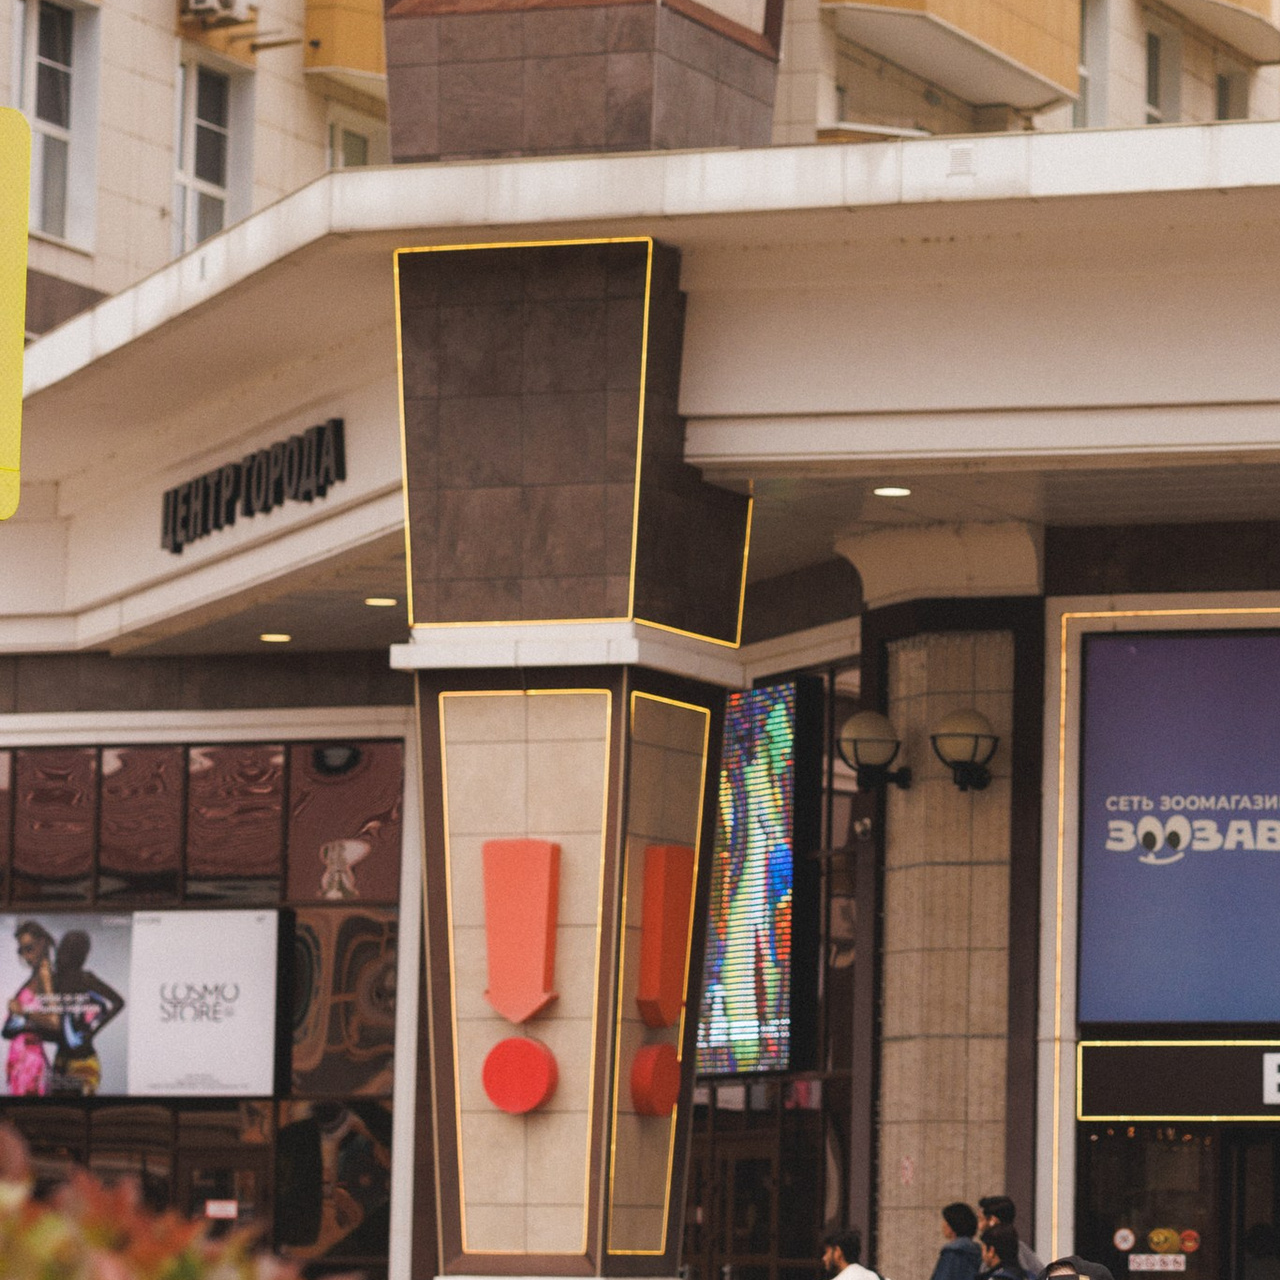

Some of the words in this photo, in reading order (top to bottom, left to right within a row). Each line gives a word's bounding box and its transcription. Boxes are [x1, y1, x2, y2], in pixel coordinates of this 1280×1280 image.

[161, 462, 241, 554] ЦЕНТР
[239, 418, 346, 517] ГОРОДА
[1106, 796, 1154, 813] СЕТЬ
